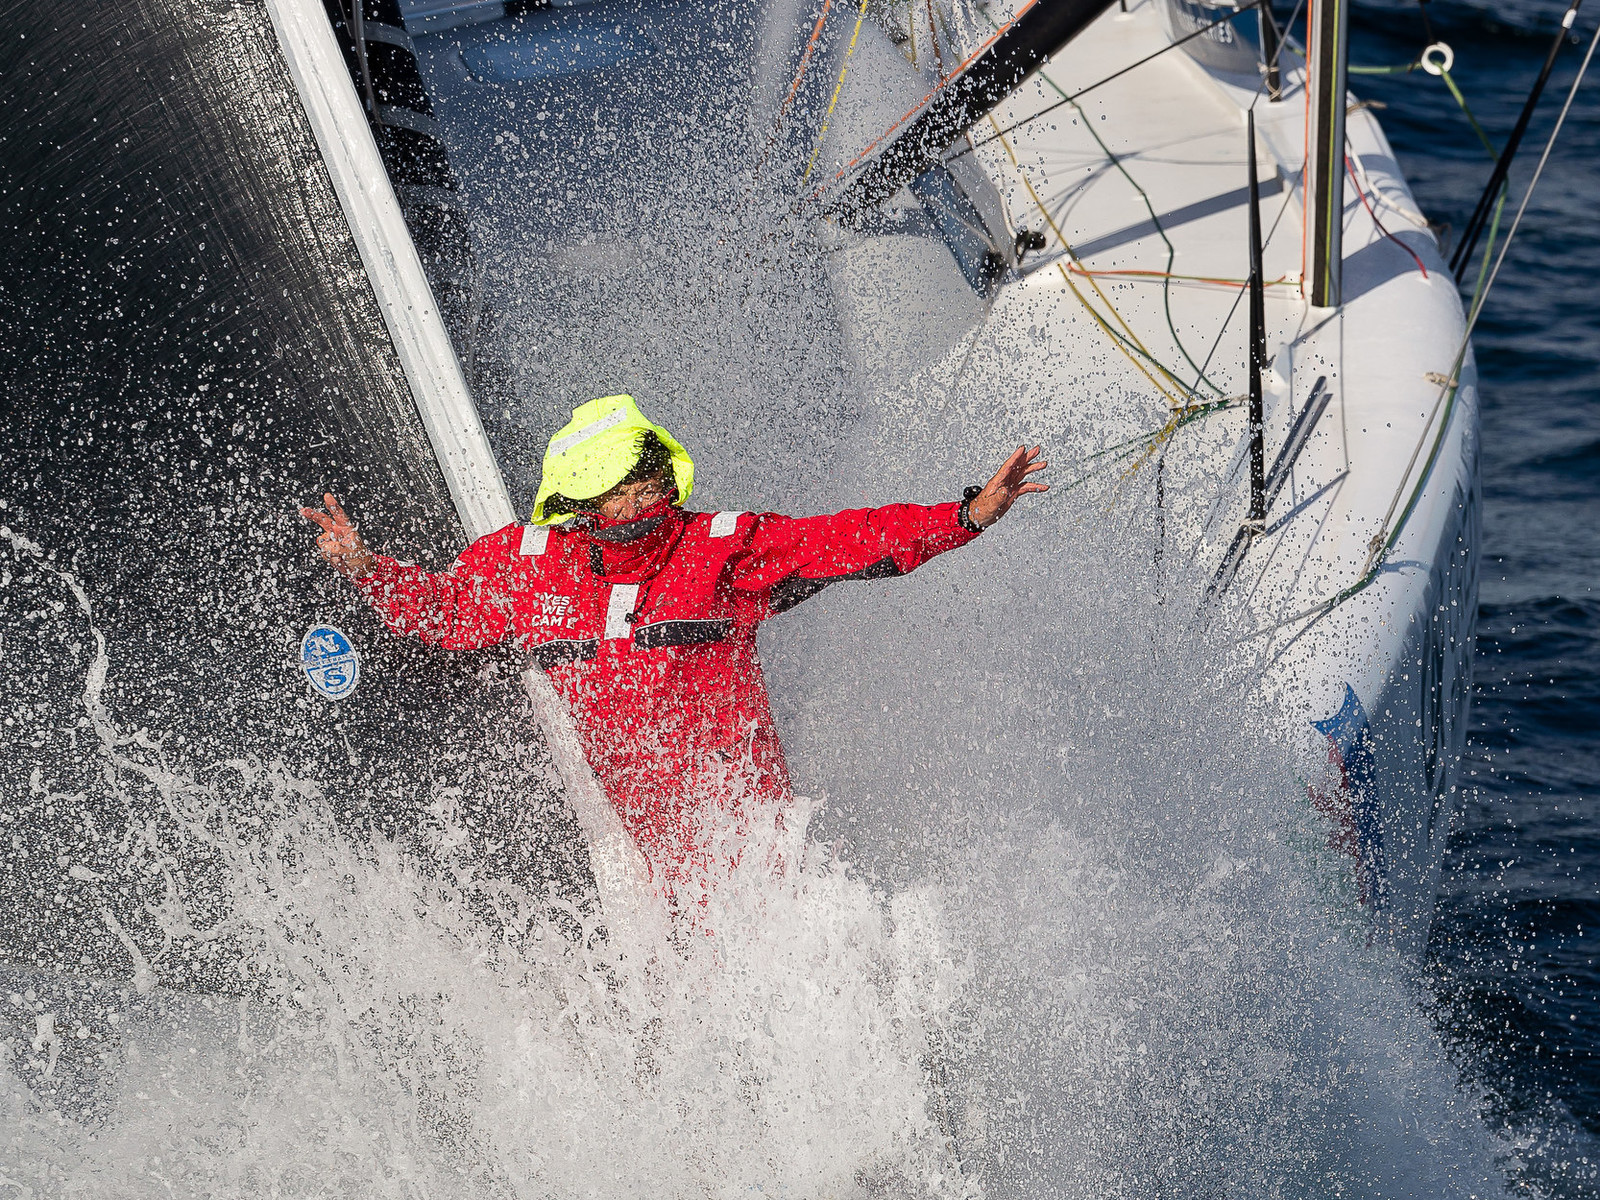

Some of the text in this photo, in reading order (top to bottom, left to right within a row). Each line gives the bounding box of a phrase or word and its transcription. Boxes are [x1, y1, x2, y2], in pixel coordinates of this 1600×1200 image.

[543, 592, 570, 606] YES
[542, 603, 566, 615] WE
[531, 615, 563, 627] CAM
[308, 633, 340, 657] N
[323, 666, 347, 688] S
